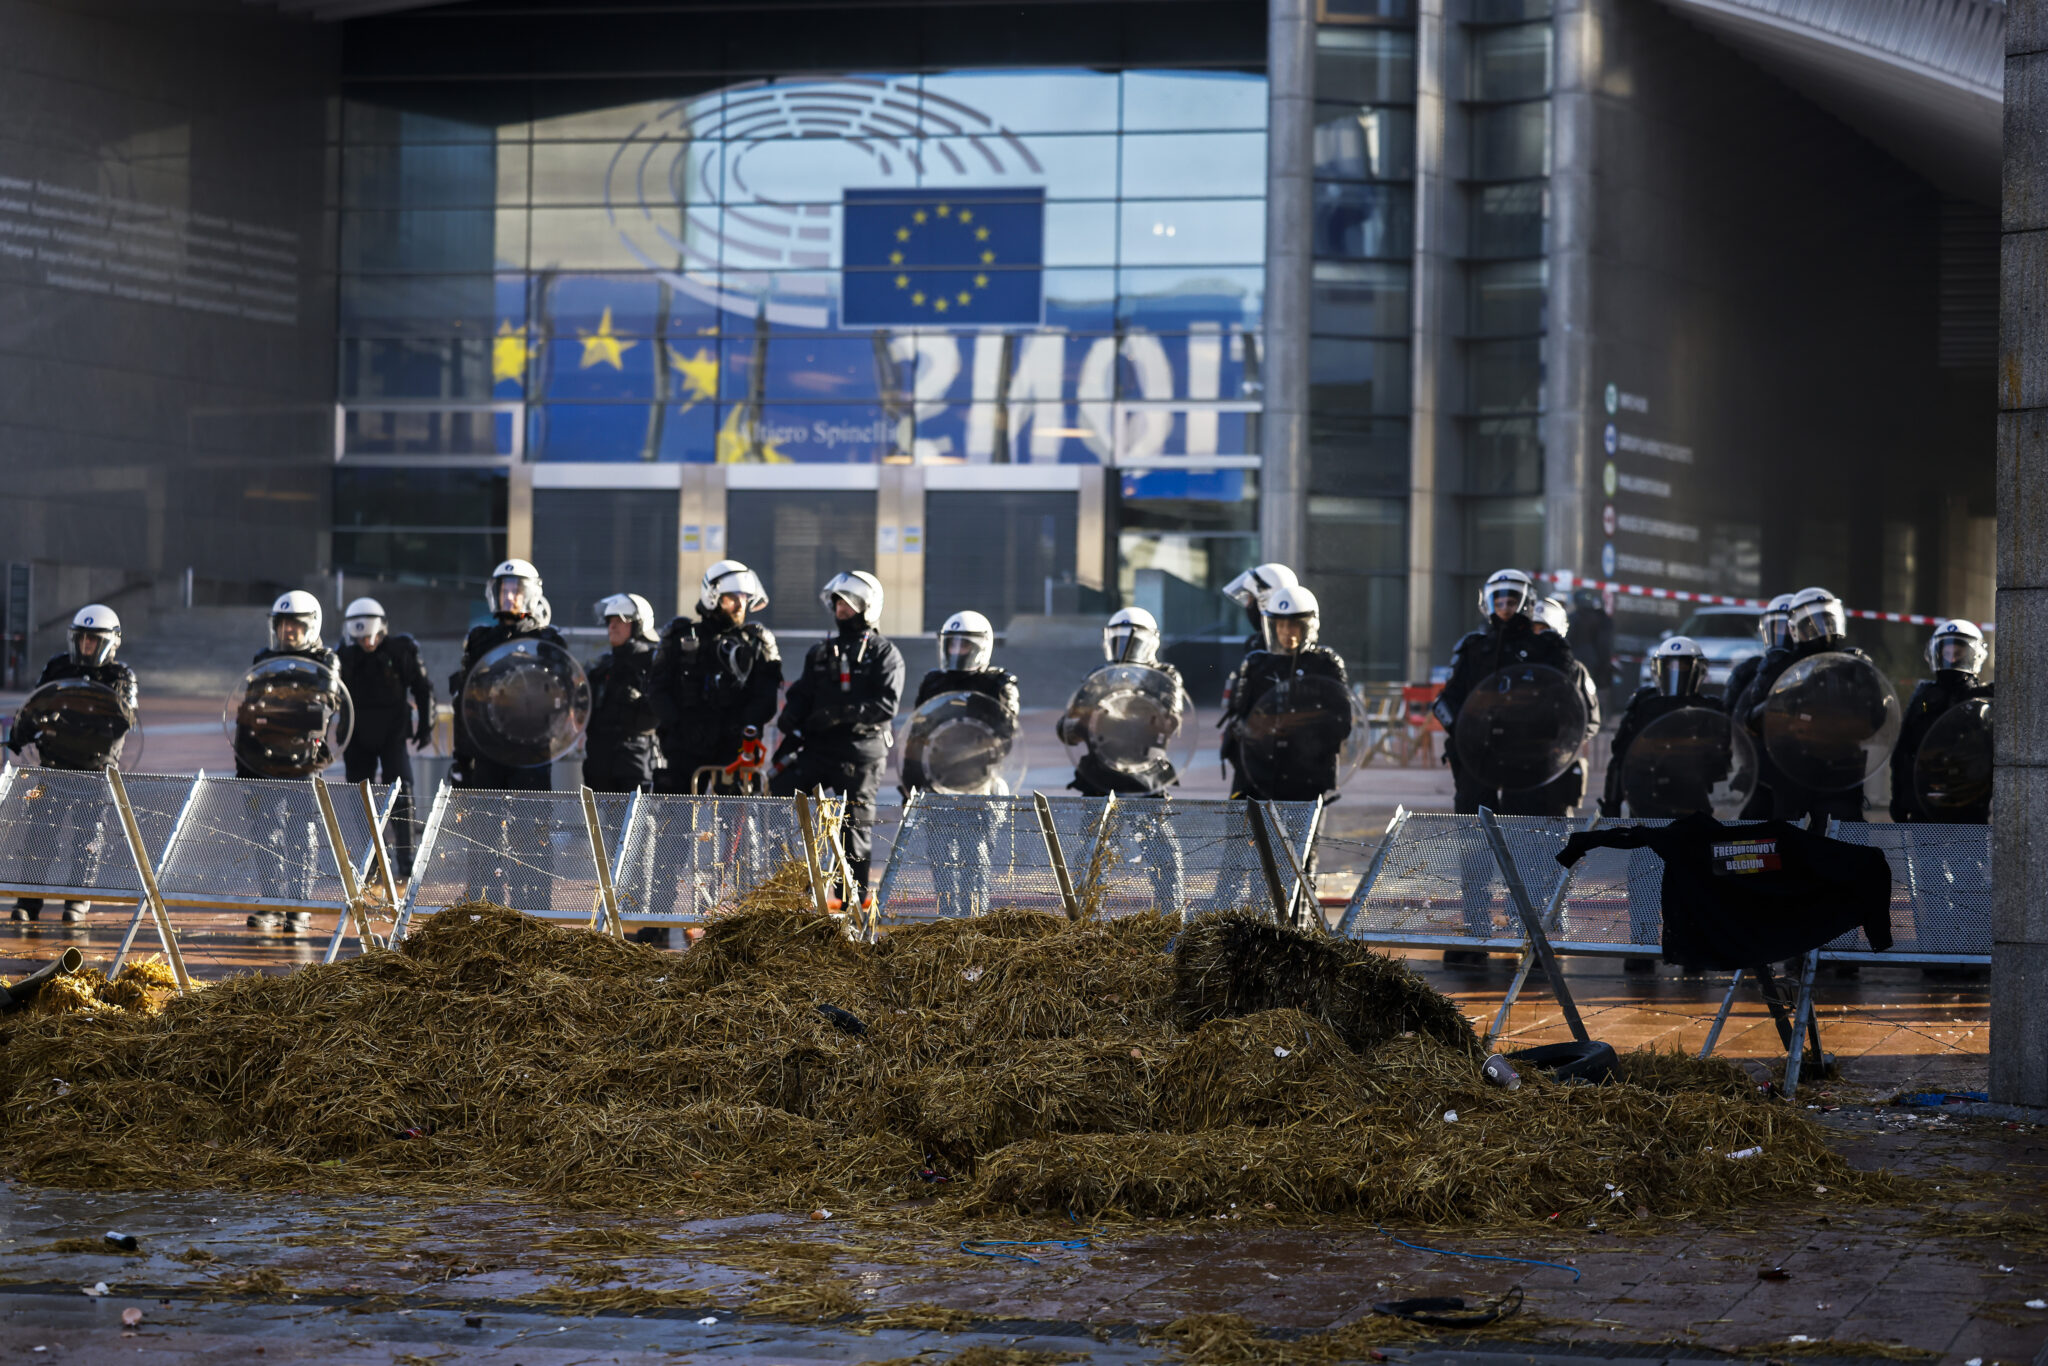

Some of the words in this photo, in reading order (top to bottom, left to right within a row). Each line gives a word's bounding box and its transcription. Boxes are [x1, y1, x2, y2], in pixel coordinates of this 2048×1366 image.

[1713, 845, 1745, 857] FREEDOM
[1746, 843, 1776, 854] CONVOY
[1726, 859, 1765, 871] BELGIUM
